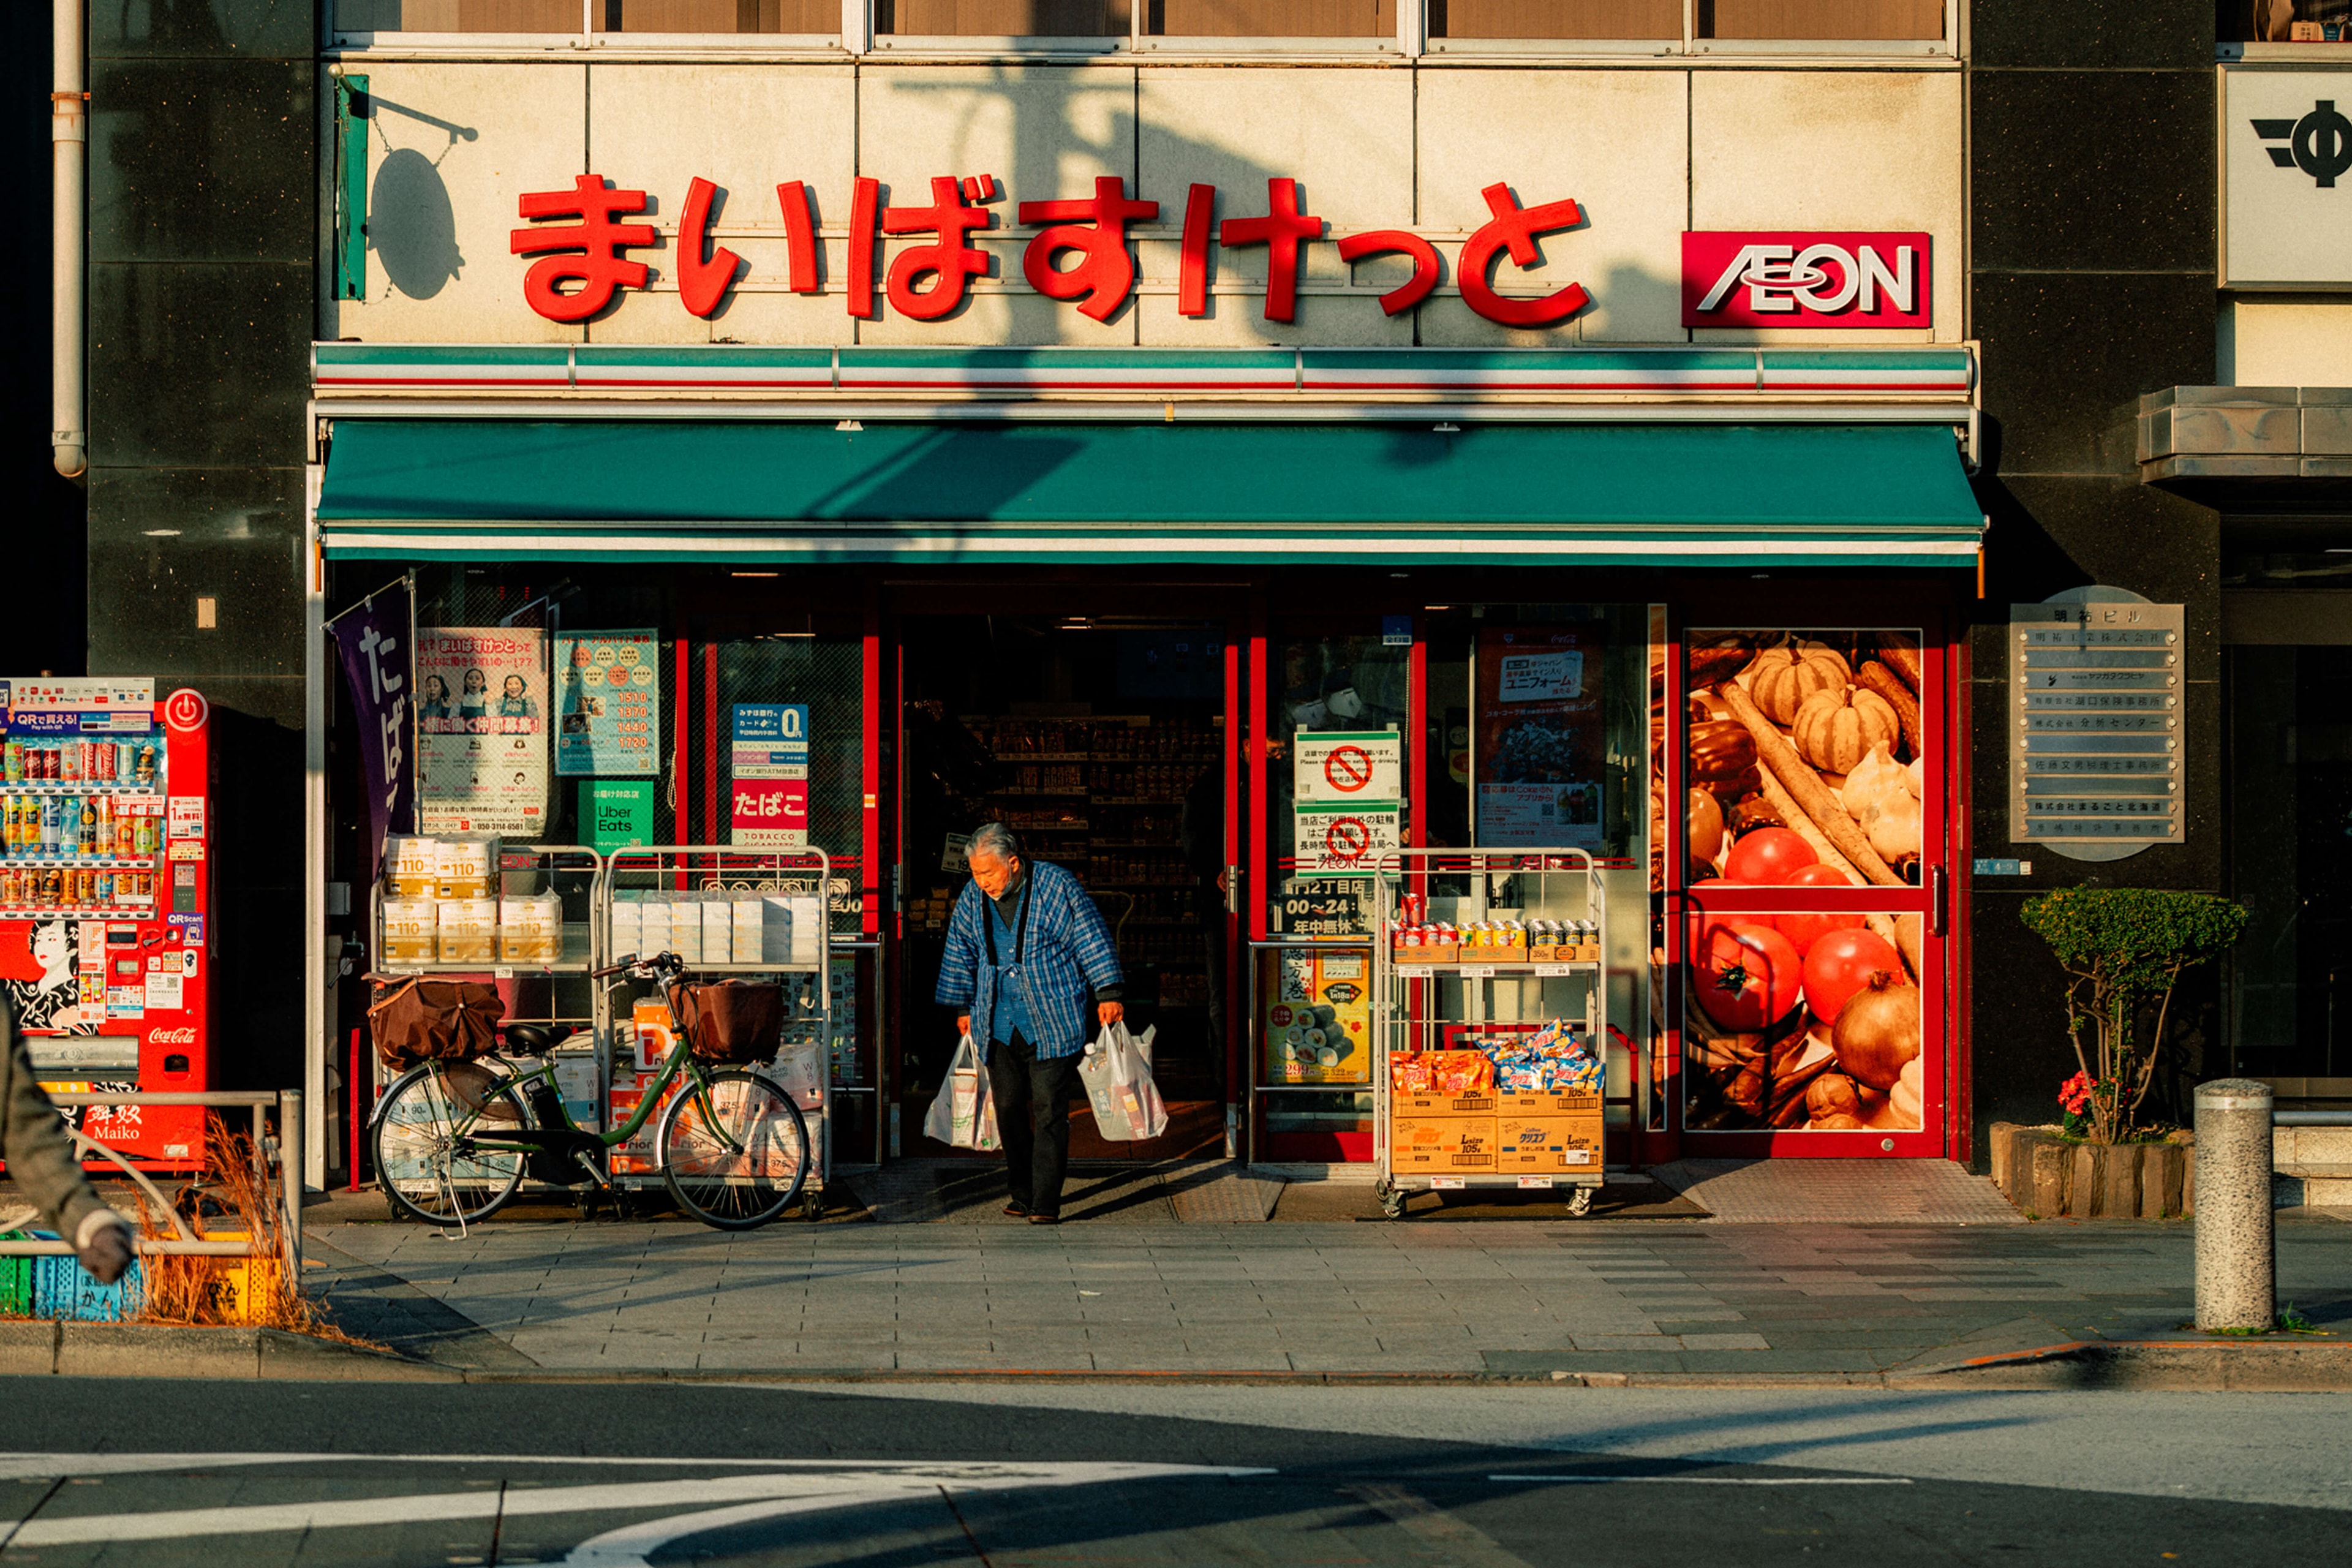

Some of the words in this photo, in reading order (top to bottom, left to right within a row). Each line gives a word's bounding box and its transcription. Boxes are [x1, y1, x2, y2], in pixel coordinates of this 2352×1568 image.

[511, 174, 1589, 326] まいばすけっと
[735, 791, 804, 816] たばこ
[2035, 802, 2160, 812] 株式会社まるごと北海道
[598, 805, 632, 818] Uber
[599, 820, 632, 832] Eats
[401, 859, 424, 872] 110
[451, 864, 474, 875] 110
[168, 914, 184, 923] QR
[1294, 919, 1352, 934] 年中無休
[94, 1125, 140, 1139] Maiko
